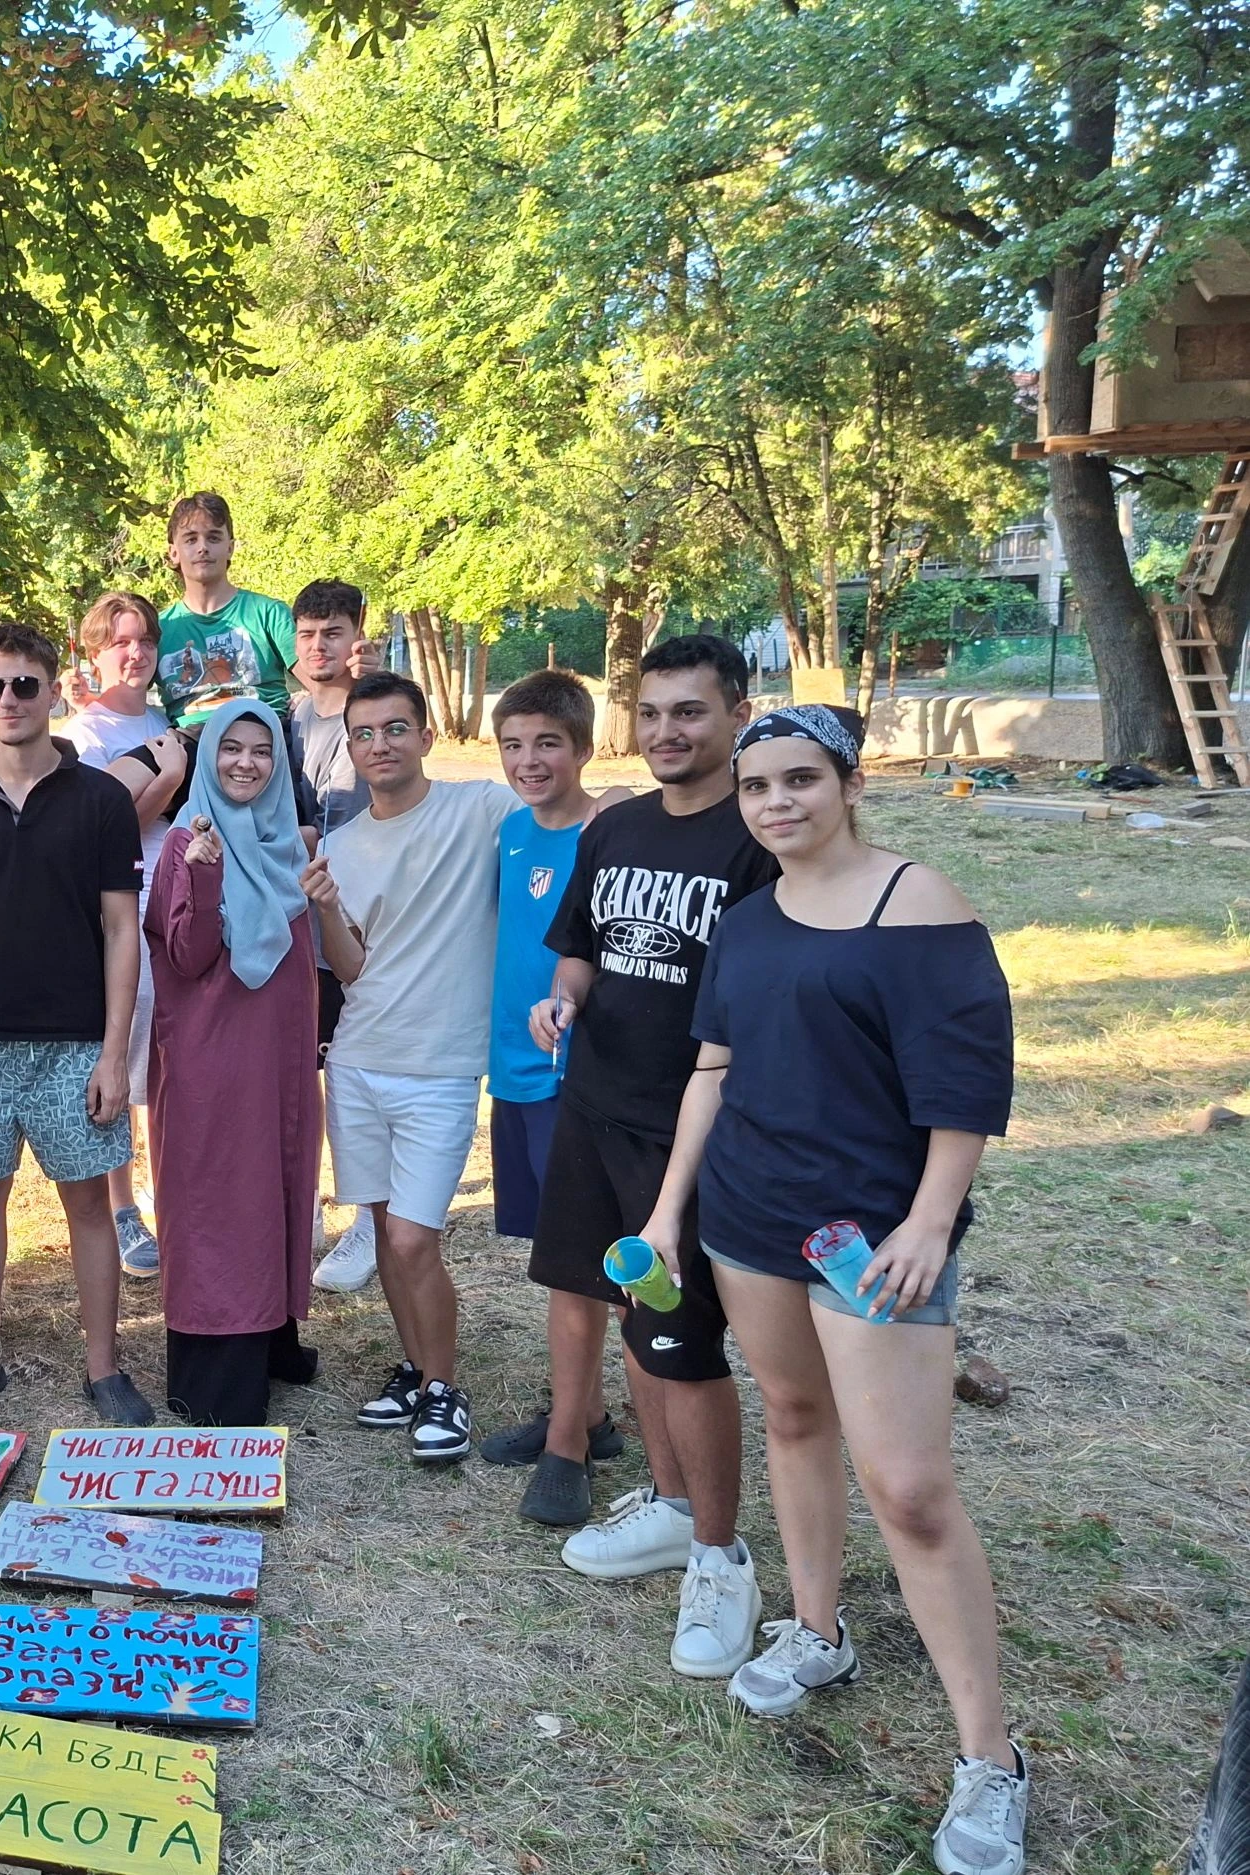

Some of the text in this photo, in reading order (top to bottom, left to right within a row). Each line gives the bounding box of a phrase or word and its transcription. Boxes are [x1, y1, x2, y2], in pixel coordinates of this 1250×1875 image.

[634, 959, 647, 977] IS
[648, 960, 689, 985] YOURS
[66, 1738, 180, 1783] БЪДЕ
